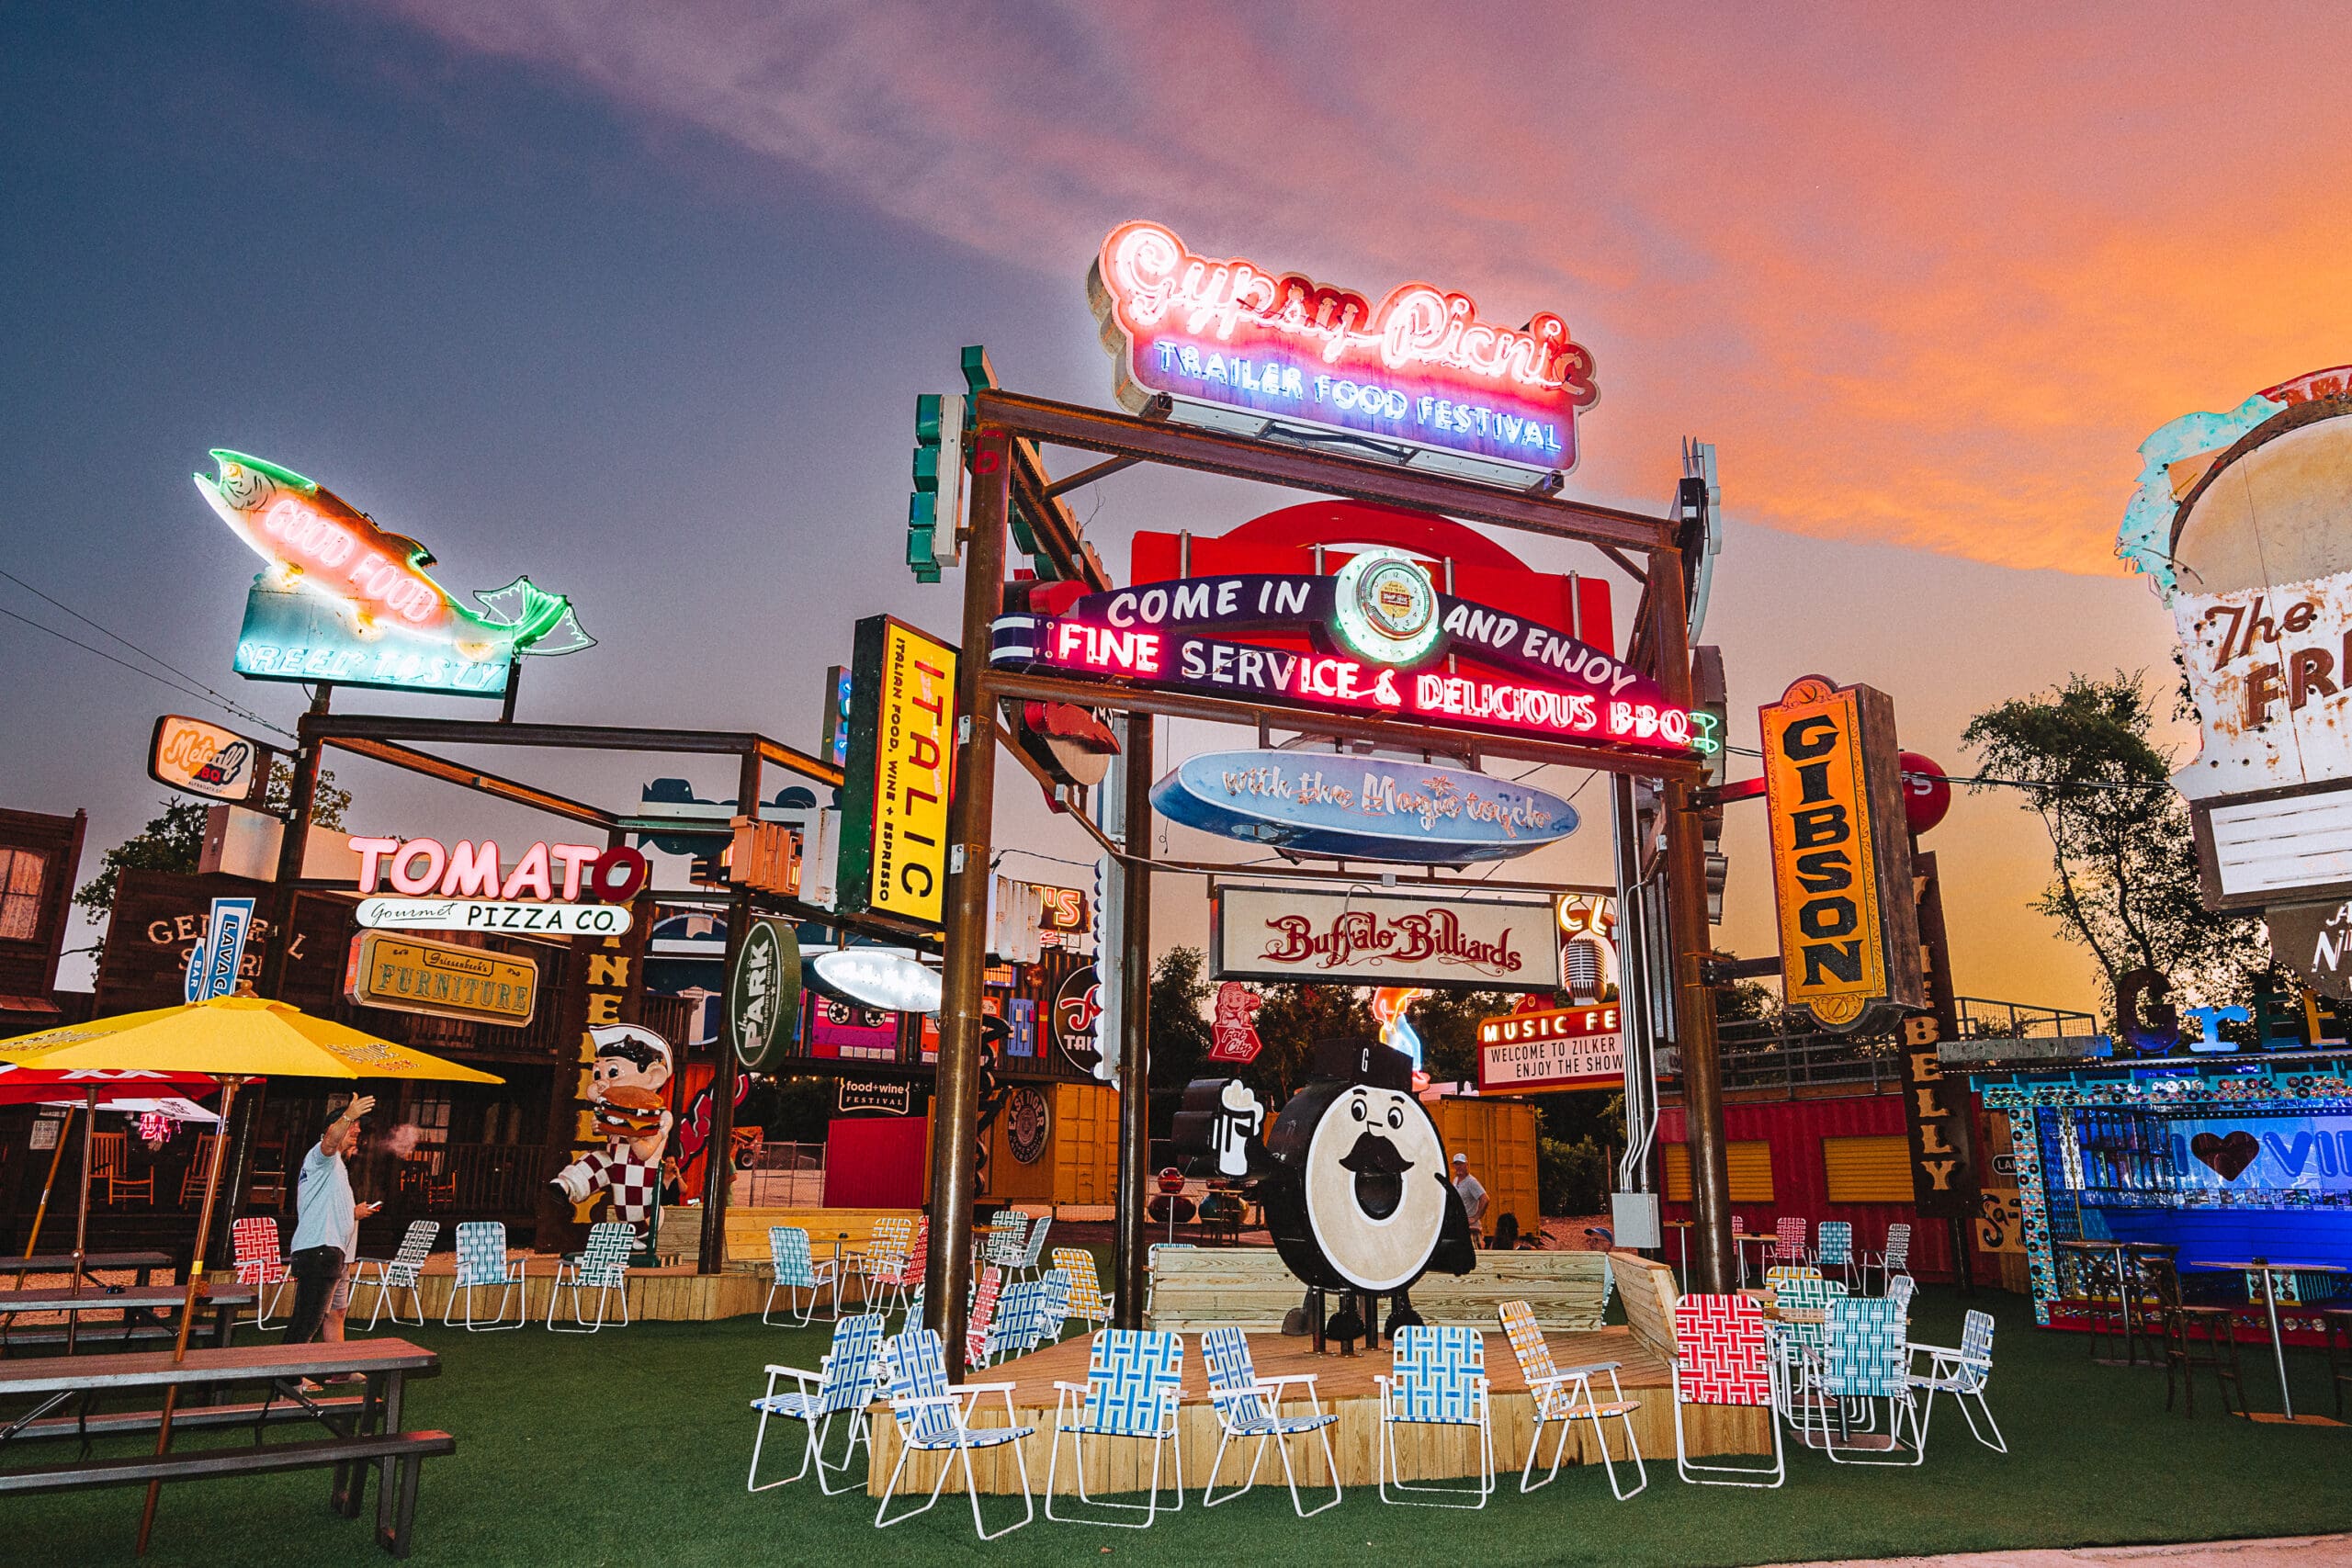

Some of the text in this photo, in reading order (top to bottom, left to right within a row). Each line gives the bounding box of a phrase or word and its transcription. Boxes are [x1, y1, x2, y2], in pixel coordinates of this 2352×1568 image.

[1115, 228, 1586, 395] Gypsy Picnic
[1154, 341, 1562, 452] TRAILER FOOD FESTIVAL
[266, 500, 437, 622] GOOD FOOD
[1107, 581, 1636, 697] COME IN AND ENJOY
[2205, 596, 2314, 672] The
[369, 652, 504, 689] TASTY
[893, 637, 905, 699] ITALIAN
[1058, 624, 1691, 745] FINE SERVICE & DELICIOUS BBQ
[888, 703, 901, 753] FOOD,
[887, 760, 898, 801] WINE
[901, 660, 944, 897] ITALIC
[1222, 766, 1552, 838] with the Magic touch
[348, 835, 648, 904] TOMATO
[879, 821, 894, 902] ESPRESSO
[1782, 715, 1864, 987] GIBSON
[370, 903, 616, 932] Gourmet PIZZA CO.
[1258, 908, 1521, 974] Buffalo Billiards
[190, 960, 201, 987] BAR
[378, 963, 528, 1011] FURNITURE
[744, 939, 769, 1048] PARK
[738, 1012, 748, 1032] the
[1222, 1029, 1247, 1043] Fat
[1225, 1040, 1253, 1057] City
[1484, 1015, 1567, 1043] MUSIC
[1491, 1037, 1615, 1063] WELCOME TO ZILKER
[1361, 1047, 1369, 1072] G
[1517, 1053, 1623, 1077] ENJOY THE SHOW
[846, 1096, 902, 1106] FESTIVAL
[1009, 1090, 1044, 1130] EASY TIGER
[1903, 1016, 1956, 1190] BELLY
